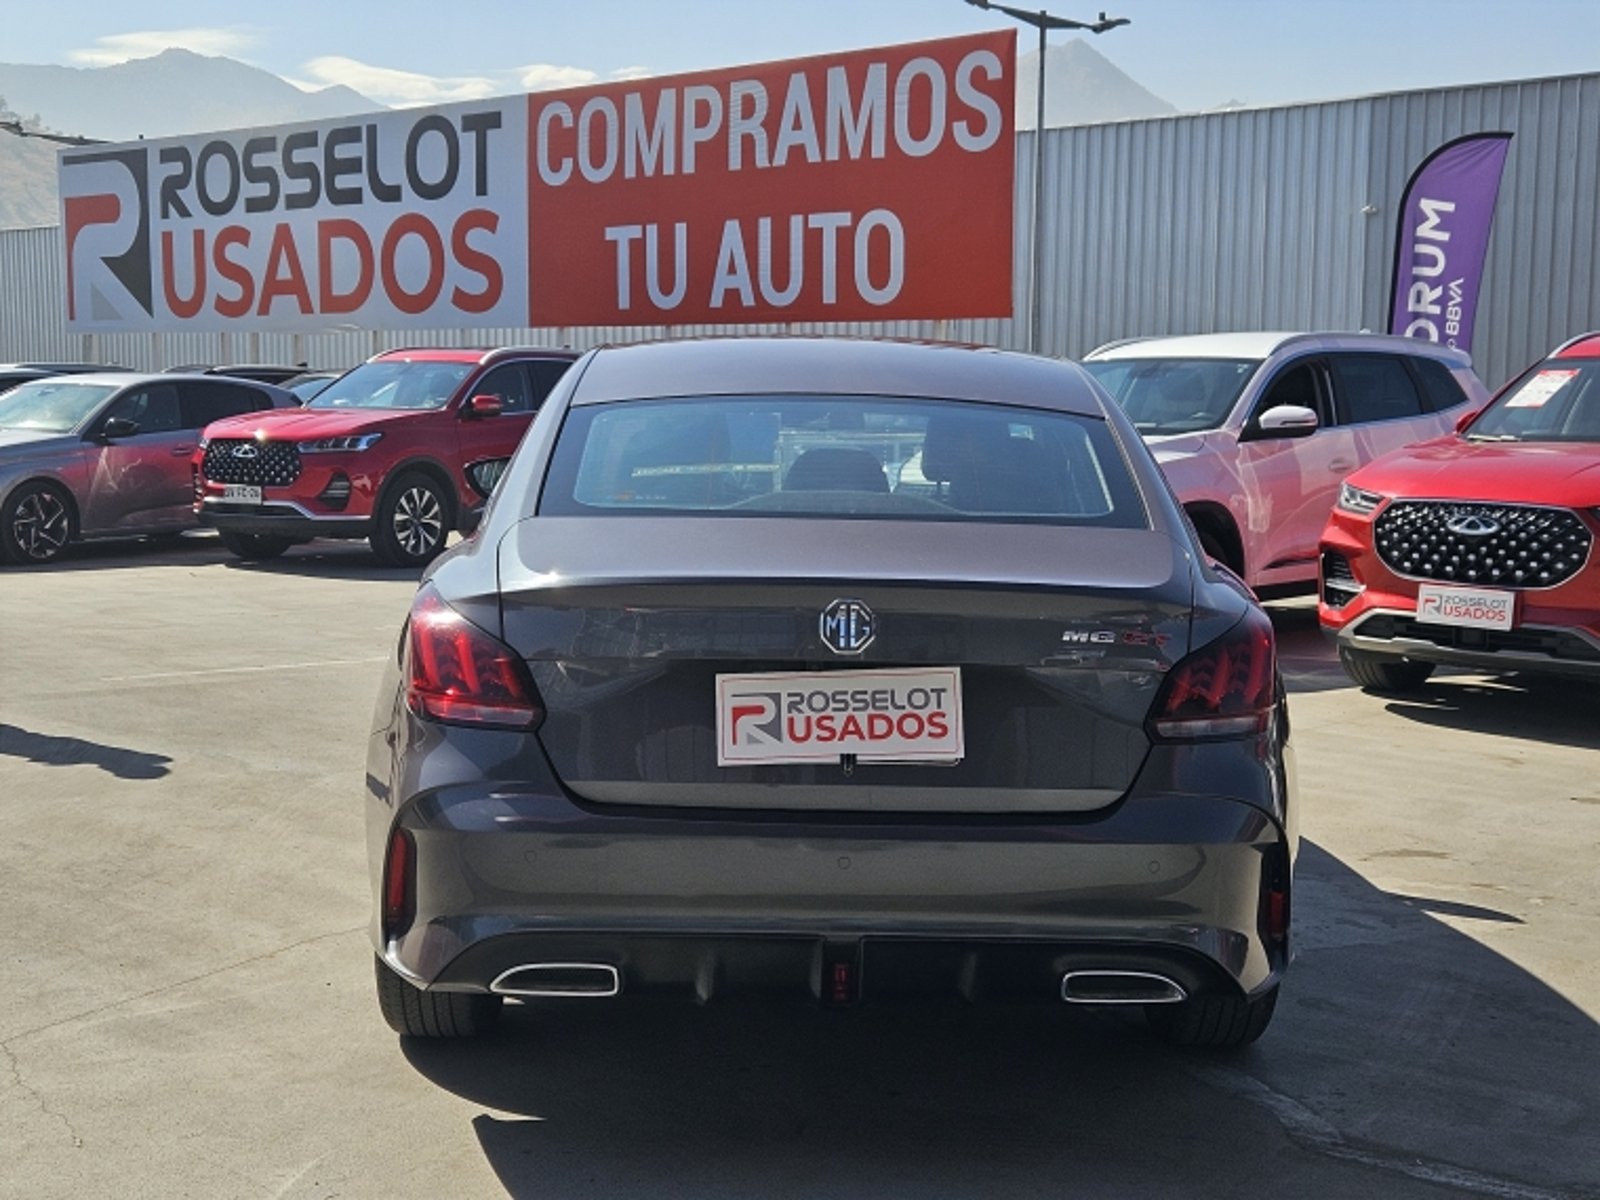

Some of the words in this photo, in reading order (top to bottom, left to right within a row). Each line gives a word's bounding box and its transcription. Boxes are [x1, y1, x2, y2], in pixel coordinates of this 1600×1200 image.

[536, 49, 1003, 186] COMPRAMOS
[159, 110, 502, 220] ROSSELOT
[161, 208, 504, 319] USADOS
[605, 221, 688, 310] TU
[709, 208, 905, 308] AUTO
[1445, 278, 1465, 336] BBVA
[825, 603, 871, 649] MG
[1443, 595, 1508, 609] ROSSELOT
[1443, 605, 1507, 622] USADOS
[786, 688, 948, 715] ROSSELOT
[787, 711, 949, 744] USADOS
